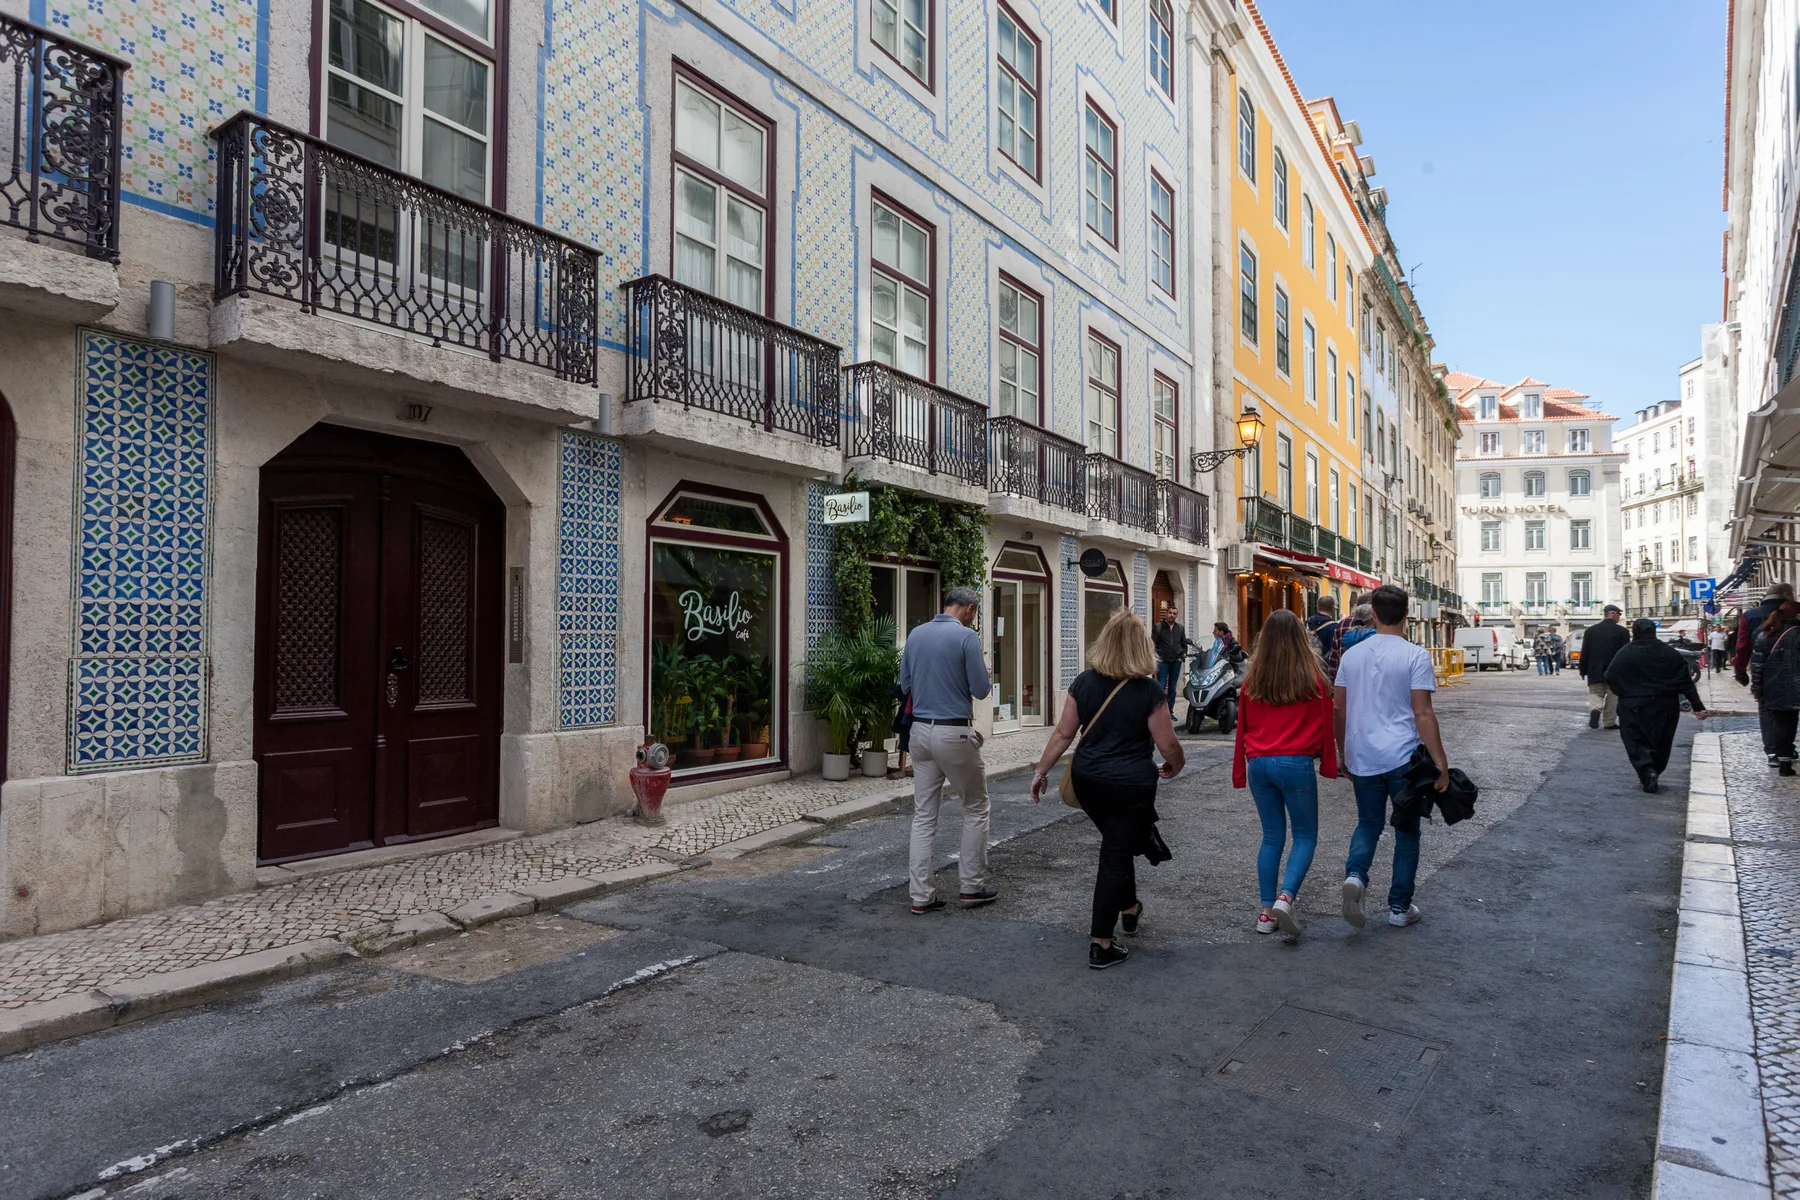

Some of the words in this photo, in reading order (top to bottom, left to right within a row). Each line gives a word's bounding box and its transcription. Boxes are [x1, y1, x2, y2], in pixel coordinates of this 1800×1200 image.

[826, 495, 863, 520] Basilio
[1460, 505, 1507, 517] TURIM
[1515, 504, 1566, 514] HOTEL
[1694, 580, 1711, 598] P
[679, 589, 753, 640] Basilio
